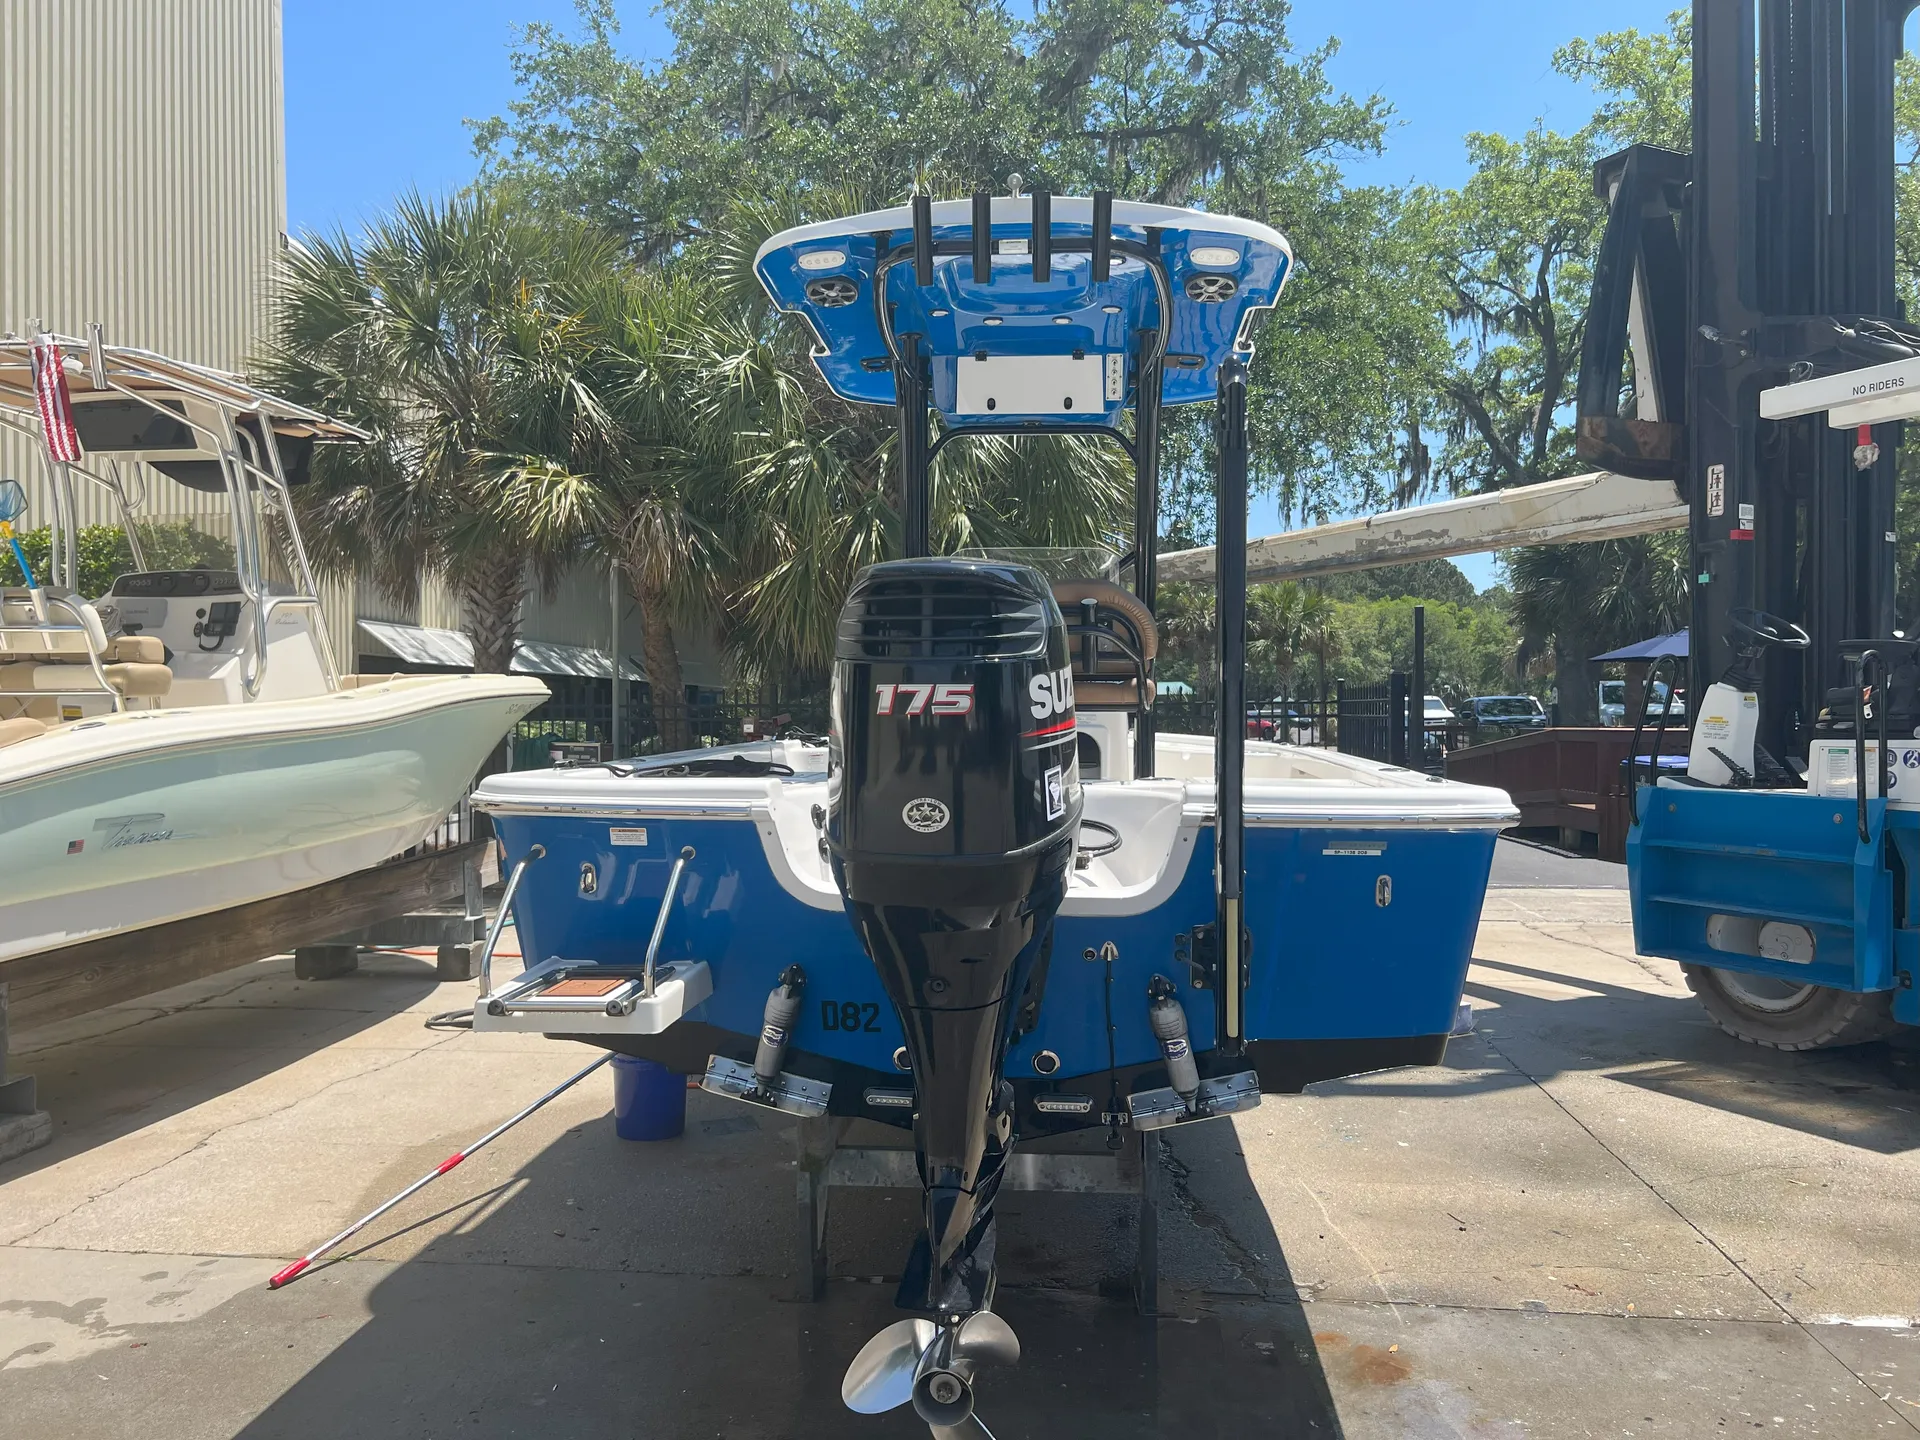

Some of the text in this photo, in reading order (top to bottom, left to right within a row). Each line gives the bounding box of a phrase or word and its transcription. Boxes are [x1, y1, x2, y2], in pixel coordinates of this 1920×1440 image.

[1852, 376, 1905, 396] NO RIDERS
[875, 683, 975, 716] 175
[821, 1000, 881, 1033] D82
